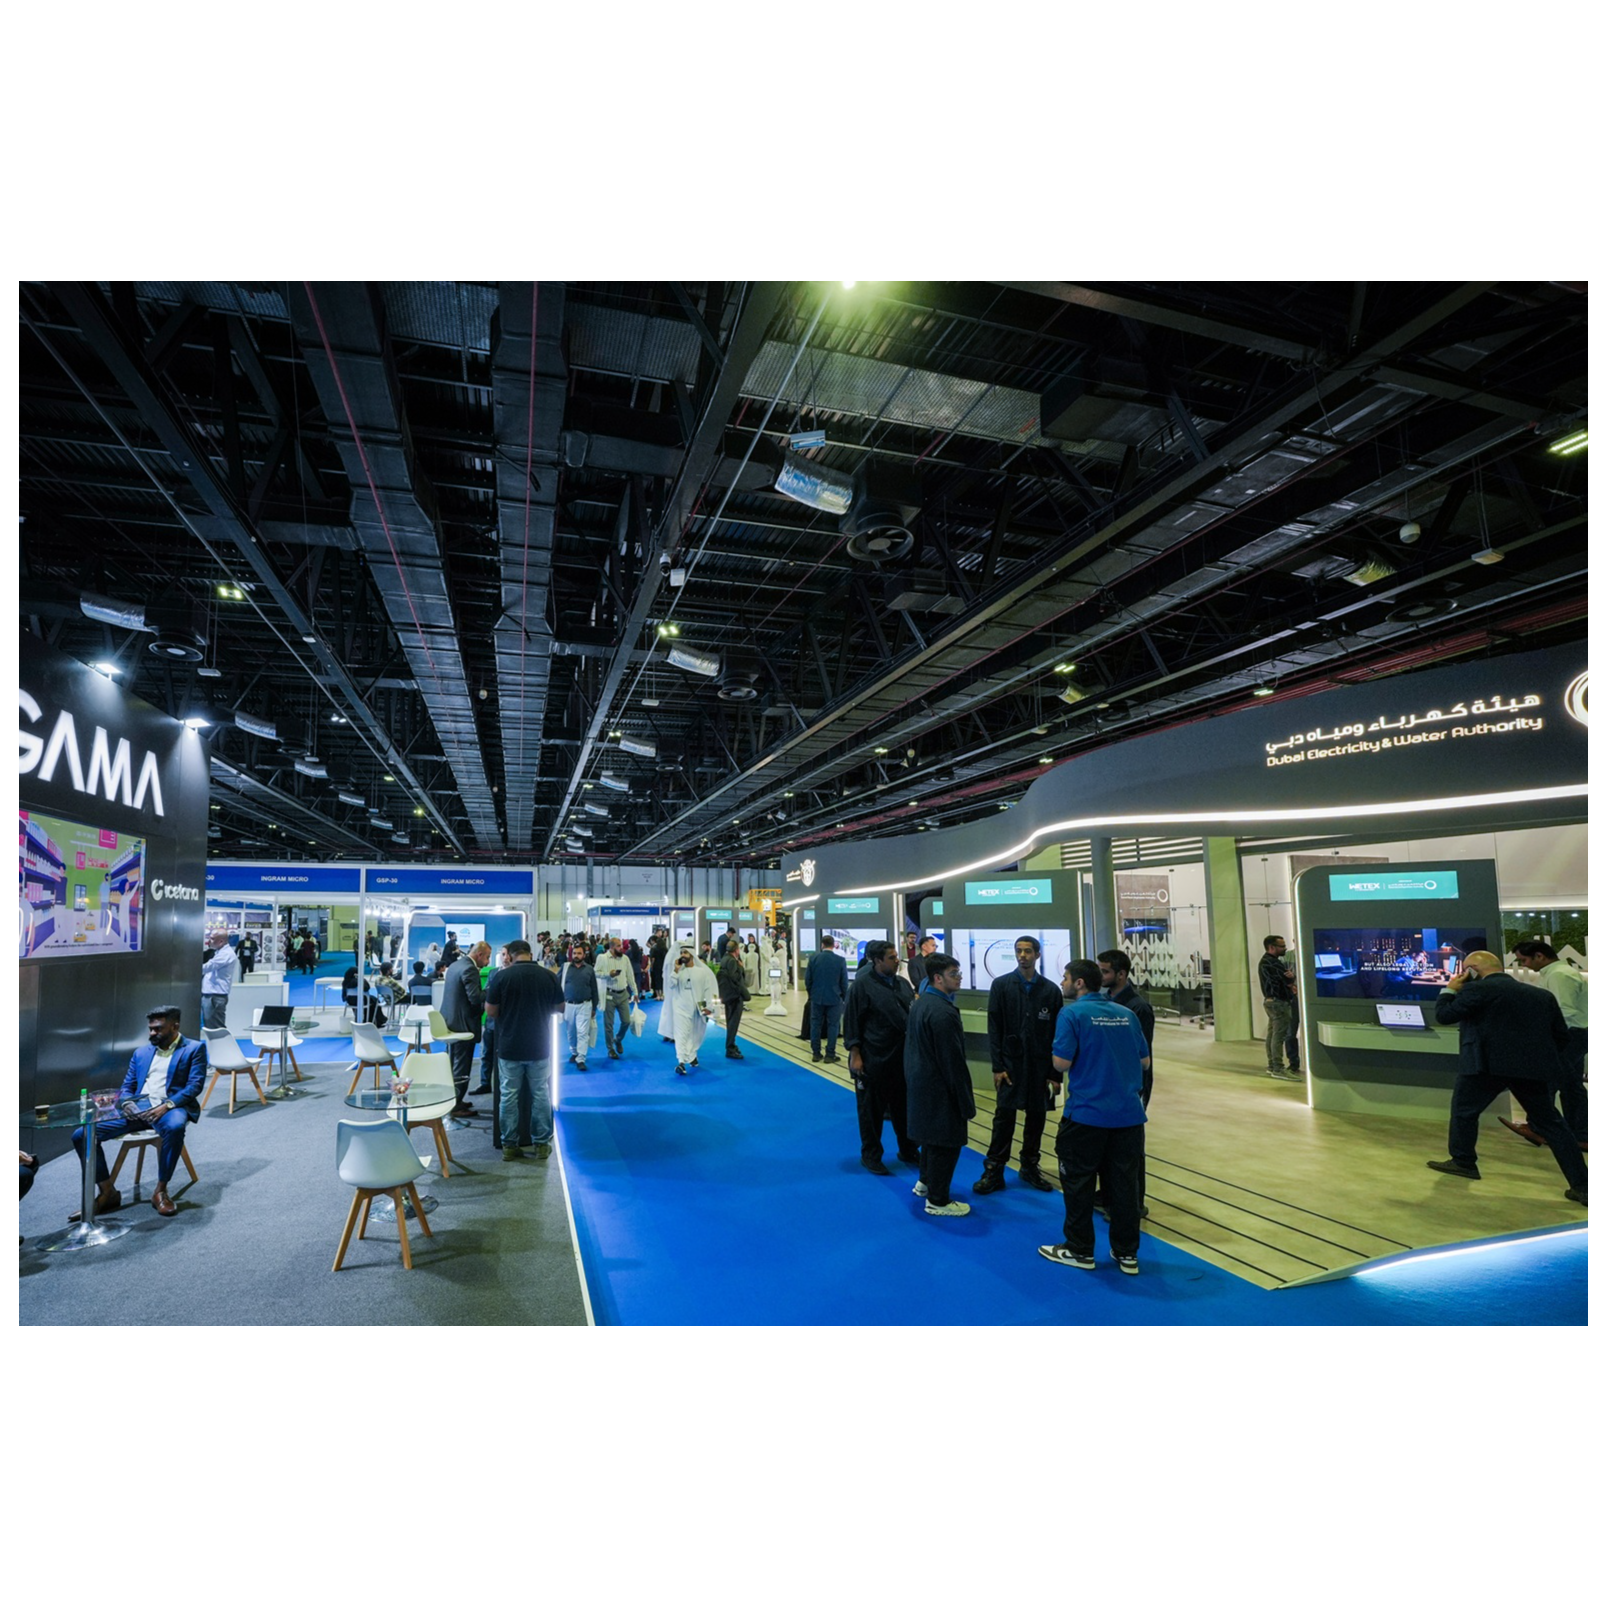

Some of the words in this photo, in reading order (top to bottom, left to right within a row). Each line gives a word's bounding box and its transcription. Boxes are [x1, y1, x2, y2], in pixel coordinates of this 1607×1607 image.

[1471, 694, 1541, 714] هيئة
[1367, 702, 1469, 732] كهرباء
[1266, 750, 1305, 767] Dubai
[1306, 740, 1381, 760] Electricity
[1381, 737, 1392, 749] &
[1393, 730, 1448, 747] Water
[1451, 717, 1543, 739] Authority
[1306, 723, 1364, 742] ومياه
[1265, 734, 1304, 754] دبي
[1348, 882, 1380, 890] WETEX
